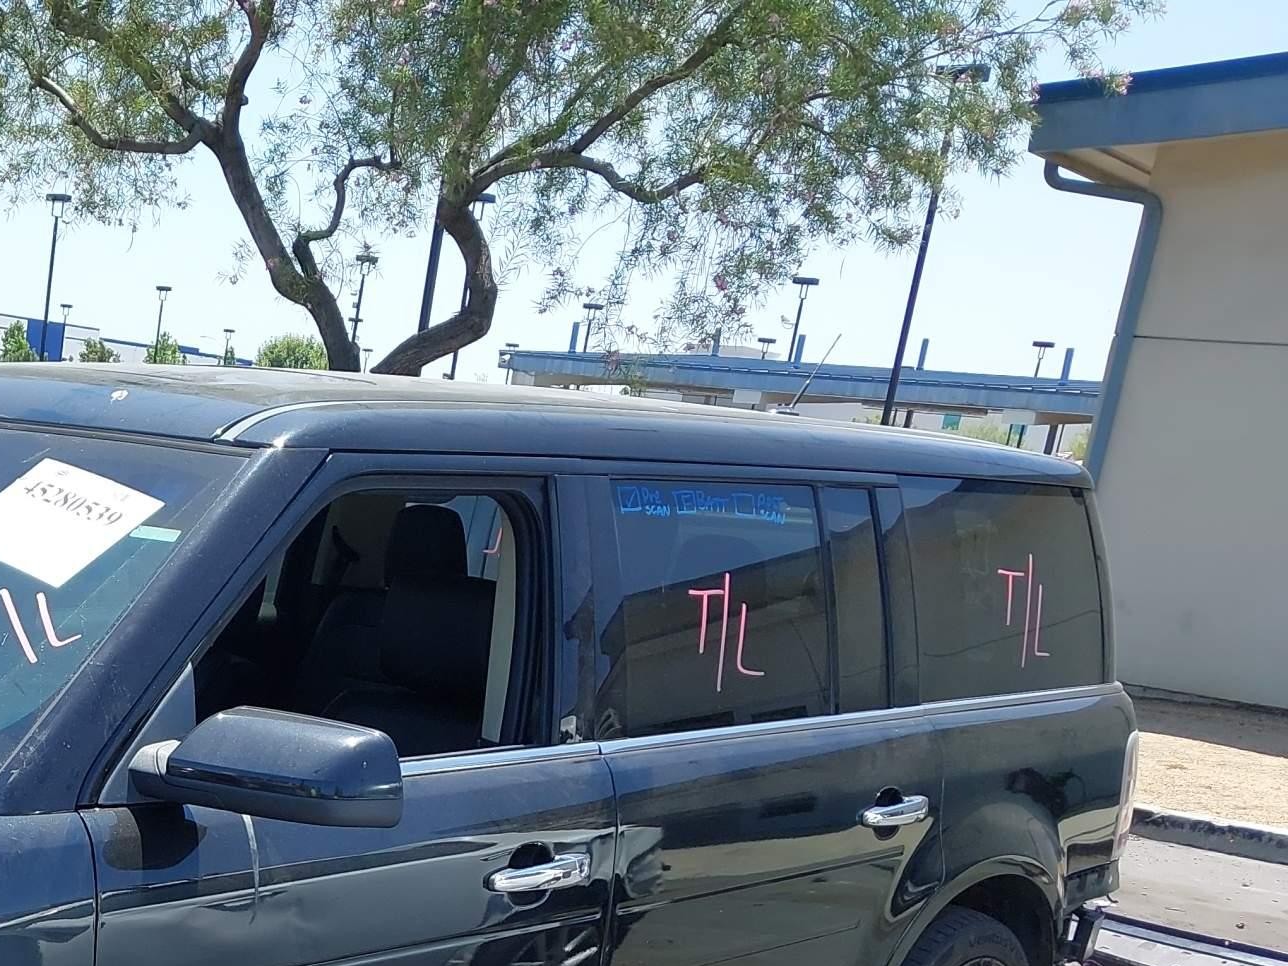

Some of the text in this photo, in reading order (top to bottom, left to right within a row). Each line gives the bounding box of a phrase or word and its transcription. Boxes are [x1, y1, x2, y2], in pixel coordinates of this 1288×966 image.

[24, 480, 124, 527] 45280539
[688, 572, 765, 692] T/L
[997, 553, 1050, 668] T/L
